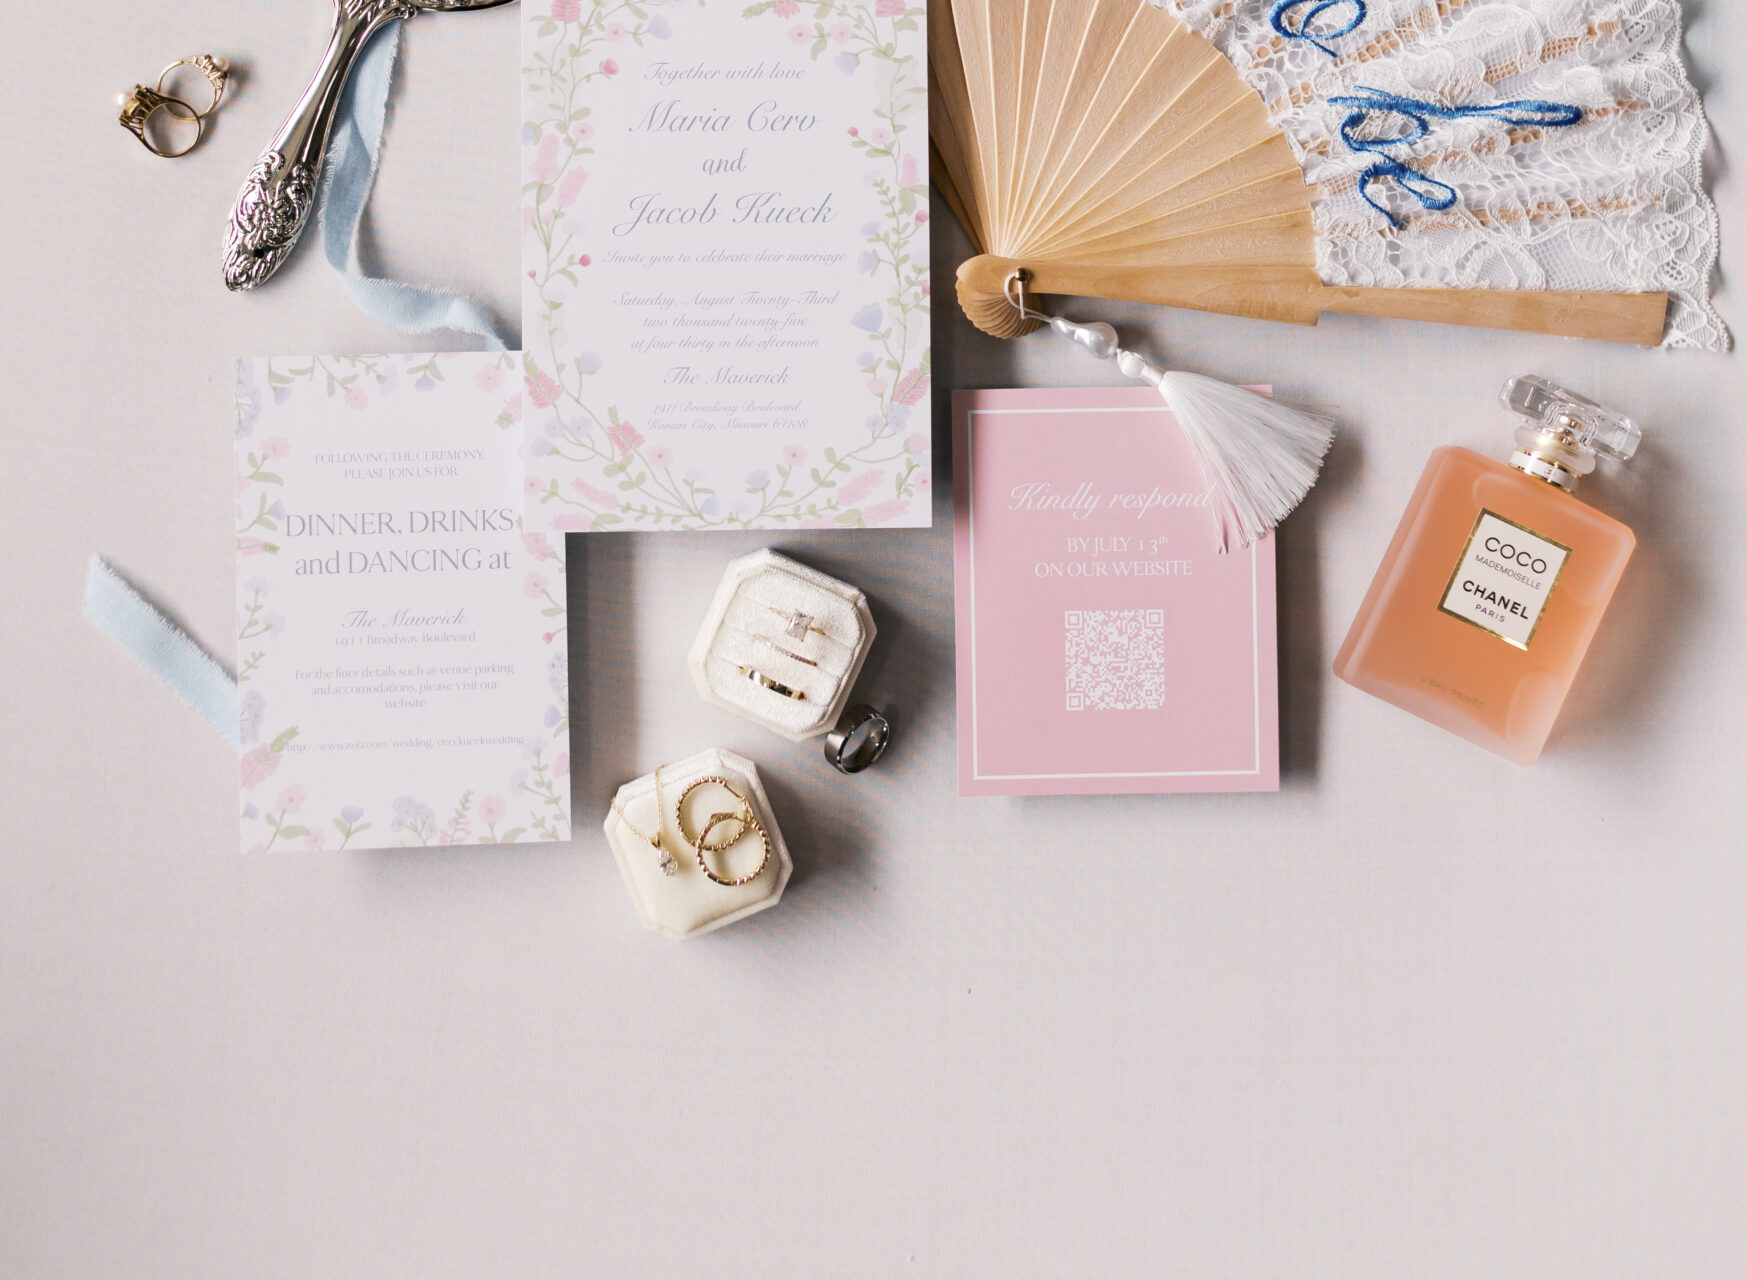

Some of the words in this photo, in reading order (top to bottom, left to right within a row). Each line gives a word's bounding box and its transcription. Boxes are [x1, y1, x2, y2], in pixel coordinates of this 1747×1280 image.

[644, 62, 721, 87] Together
[725, 63, 765, 79] with
[768, 62, 807, 79] love
[628, 99, 733, 132] Maria
[702, 148, 747, 175] and
[1328, 85, 1582, 228] be
[612, 192, 721, 237] Jacob
[732, 192, 834, 224] Kueck
[603, 249, 647, 264] Invite
[645, 254, 674, 269] you
[678, 251, 691, 264] to
[695, 248, 752, 264] celebrate
[754, 248, 784, 264] their
[787, 253, 846, 267] marriage
[613, 290, 678, 310] Saturday,
[684, 290, 736, 310] August
[741, 290, 840, 309] Twenty-Third
[643, 317, 668, 328] two
[672, 312, 737, 328] thousand
[630, 338, 644, 349] at
[638, 335, 675, 353] four
[678, 335, 714, 353] thirty
[718, 338, 731, 349] in
[735, 334, 756, 348] the
[755, 334, 819, 352] afternoon
[663, 365, 700, 384] The
[705, 365, 790, 385] Maverick
[647, 419, 687, 430] Kansas
[315, 451, 388, 464] FOLLOWING
[391, 451, 414, 463] THE
[344, 468, 387, 480] PLEASE
[388, 467, 414, 481] JOIN
[416, 466, 433, 478] US
[434, 466, 458, 477] FOR
[1008, 482, 1102, 520] Kindly
[1108, 483, 1218, 520] respond
[286, 512, 403, 537] DINNER,
[409, 509, 514, 533] DRINKS
[1067, 537, 1092, 553] BY
[1091, 536, 1132, 557] JULY
[1485, 537, 1547, 574] COCO
[295, 550, 340, 576] and
[348, 547, 482, 575] DANCING
[489, 550, 512, 570] at
[1034, 561, 1063, 577] ON
[1067, 561, 1108, 577] OUR
[1112, 559, 1193, 576] WEBSITE
[1475, 554, 1541, 590] MADEMOISELLE
[1463, 580, 1528, 620] CHANEL
[342, 610, 377, 628] The
[382, 607, 467, 627] Maverick
[1475, 604, 1505, 622] PARIS
[367, 633, 418, 646] Broadway
[422, 631, 476, 643] Boulevard
[296, 670, 314, 680] For
[315, 668, 333, 680] the
[335, 668, 360, 679] finer
[361, 666, 396, 678] details
[398, 665, 424, 677] such
[426, 667, 438, 676] as
[439, 665, 472, 675] venue
[474, 662, 514, 676] parking
[311, 684, 331, 695] and
[419, 681, 453, 693] please
[455, 680, 477, 691] visit
[479, 680, 499, 690] our
[384, 697, 427, 709] website
